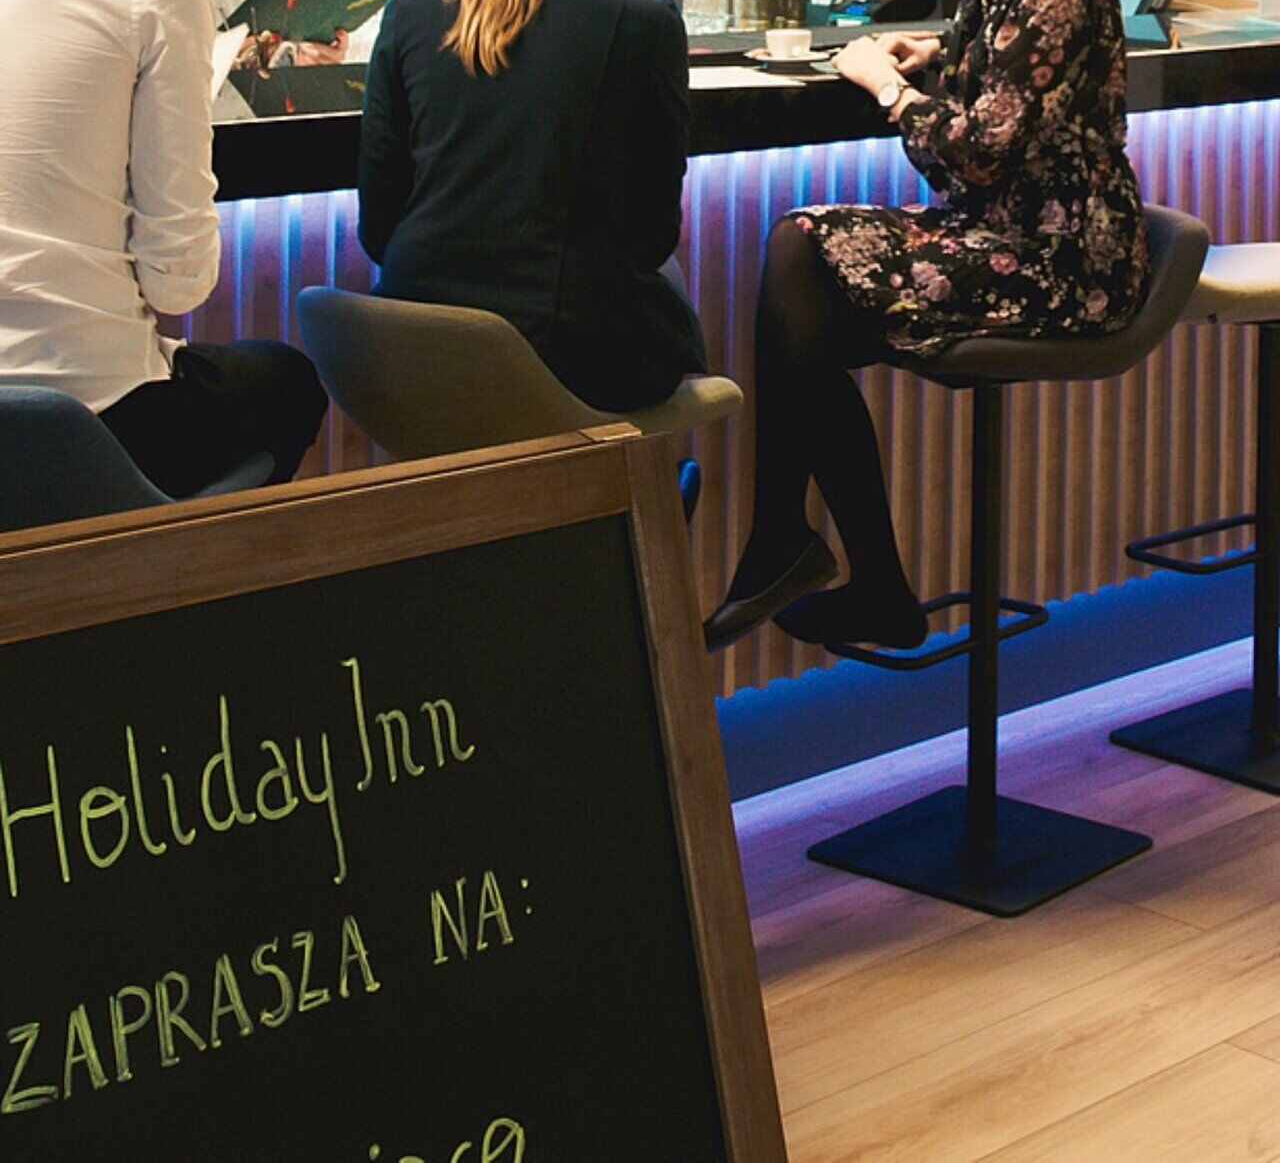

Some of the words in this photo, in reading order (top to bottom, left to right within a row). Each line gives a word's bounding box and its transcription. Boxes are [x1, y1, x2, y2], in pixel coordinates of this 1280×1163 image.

[340, 656, 476, 792] Inn
[0, 914, 382, 1116] ZAPRASZA
[430, 869, 538, 967] NA:
